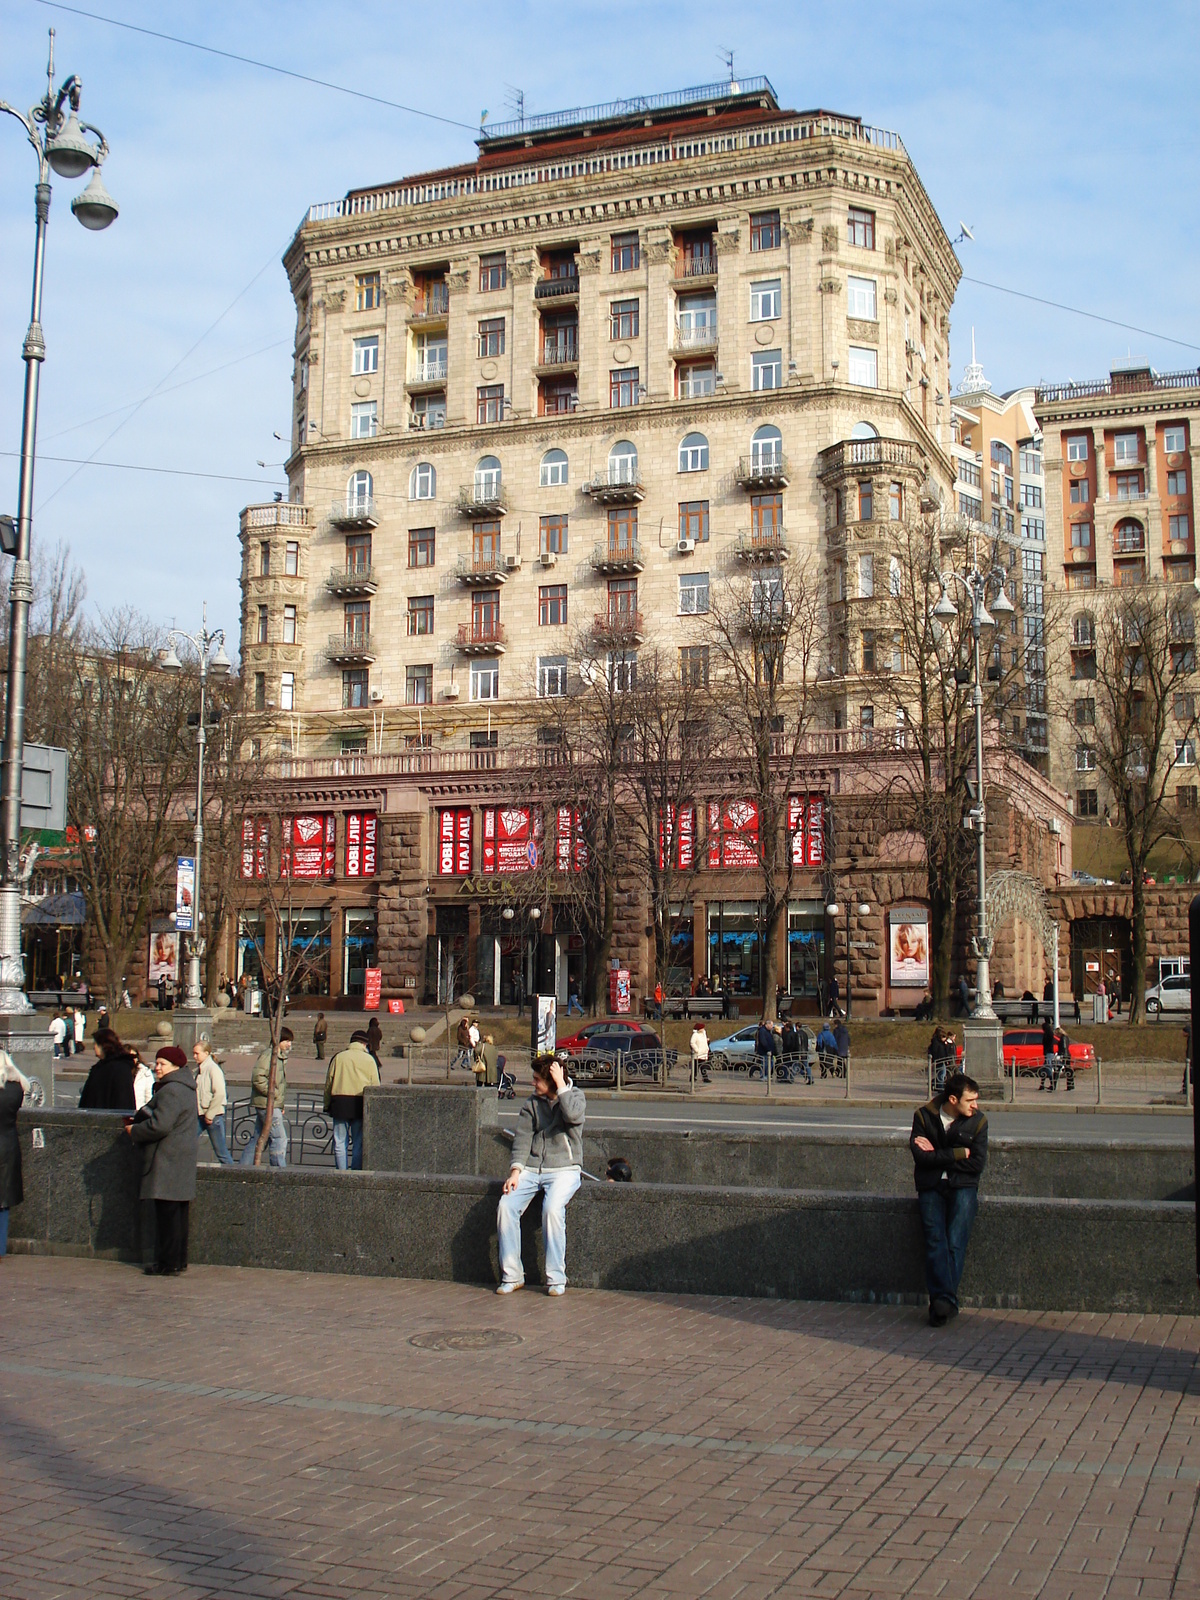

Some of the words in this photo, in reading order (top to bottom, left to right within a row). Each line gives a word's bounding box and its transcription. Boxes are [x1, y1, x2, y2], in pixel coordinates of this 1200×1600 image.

[348, 815, 360, 875] ЮВЕЛІР
[365, 819, 377, 873] ПАЛАЦ
[441, 811, 454, 873] ЮВЕЛІР
[459, 816, 471, 871] ПАЛАЦ
